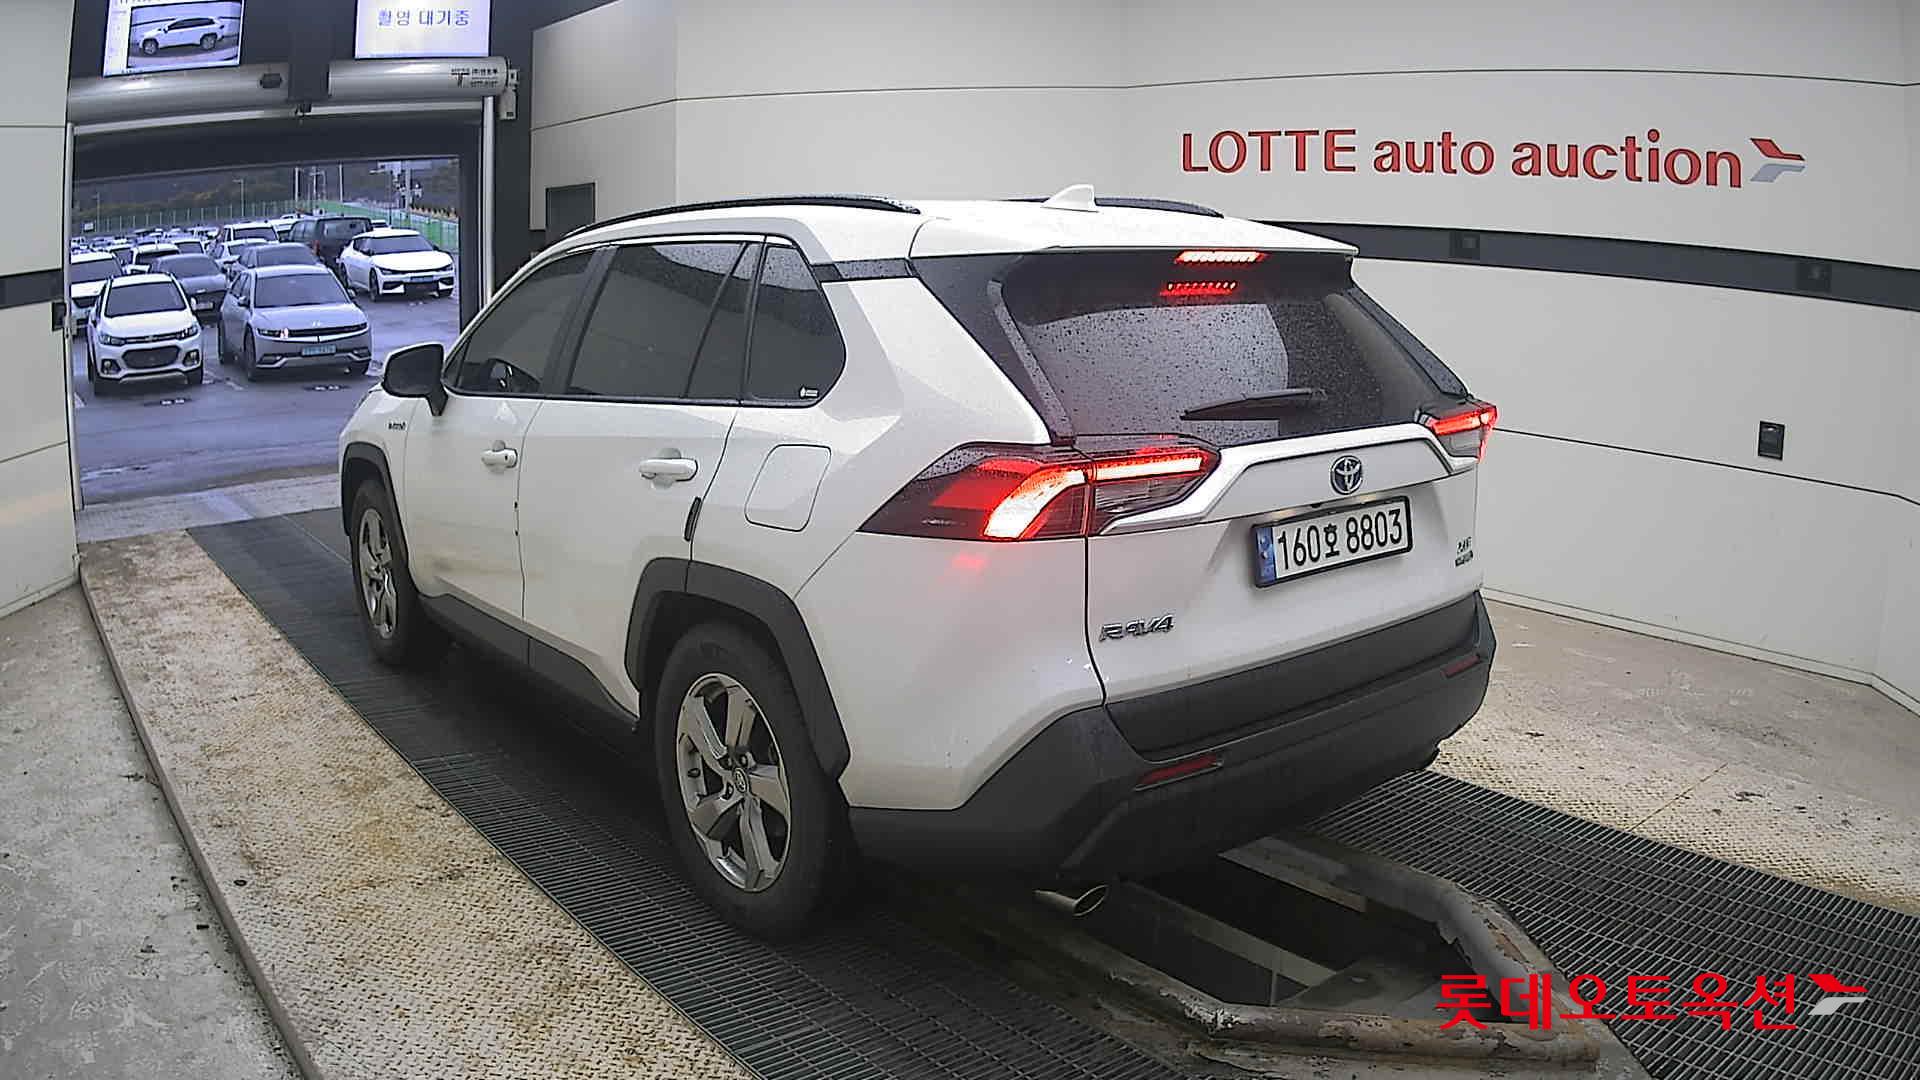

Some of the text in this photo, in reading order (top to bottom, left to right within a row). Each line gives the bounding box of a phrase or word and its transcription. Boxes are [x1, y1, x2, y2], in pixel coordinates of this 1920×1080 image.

[419, 10, 469, 26] 대기중
[1181, 128, 1743, 189] LOTTE auto auction
[1277, 508, 1403, 571] 160호 8803
[1099, 613, 1174, 642] RAV4
